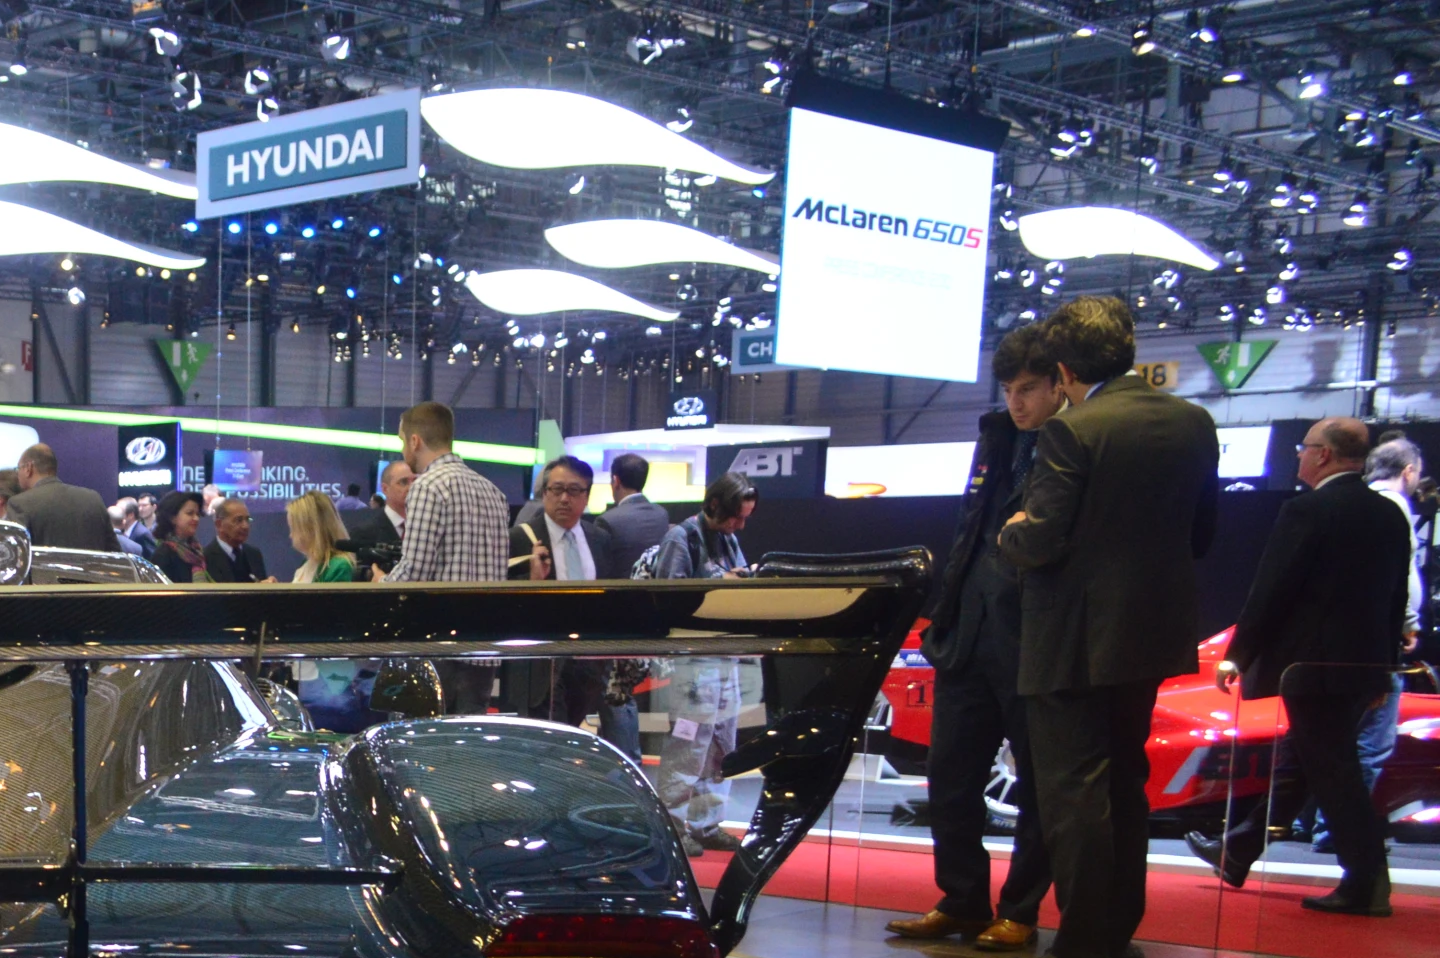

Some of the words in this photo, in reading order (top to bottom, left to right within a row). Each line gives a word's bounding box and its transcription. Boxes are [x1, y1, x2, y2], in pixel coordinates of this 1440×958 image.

[227, 124, 385, 187] HYUNDAI
[792, 197, 909, 236] McLaren
[912, 217, 983, 248] 650S
[183, 465, 205, 482] NE
[726, 447, 803, 477] ABT
